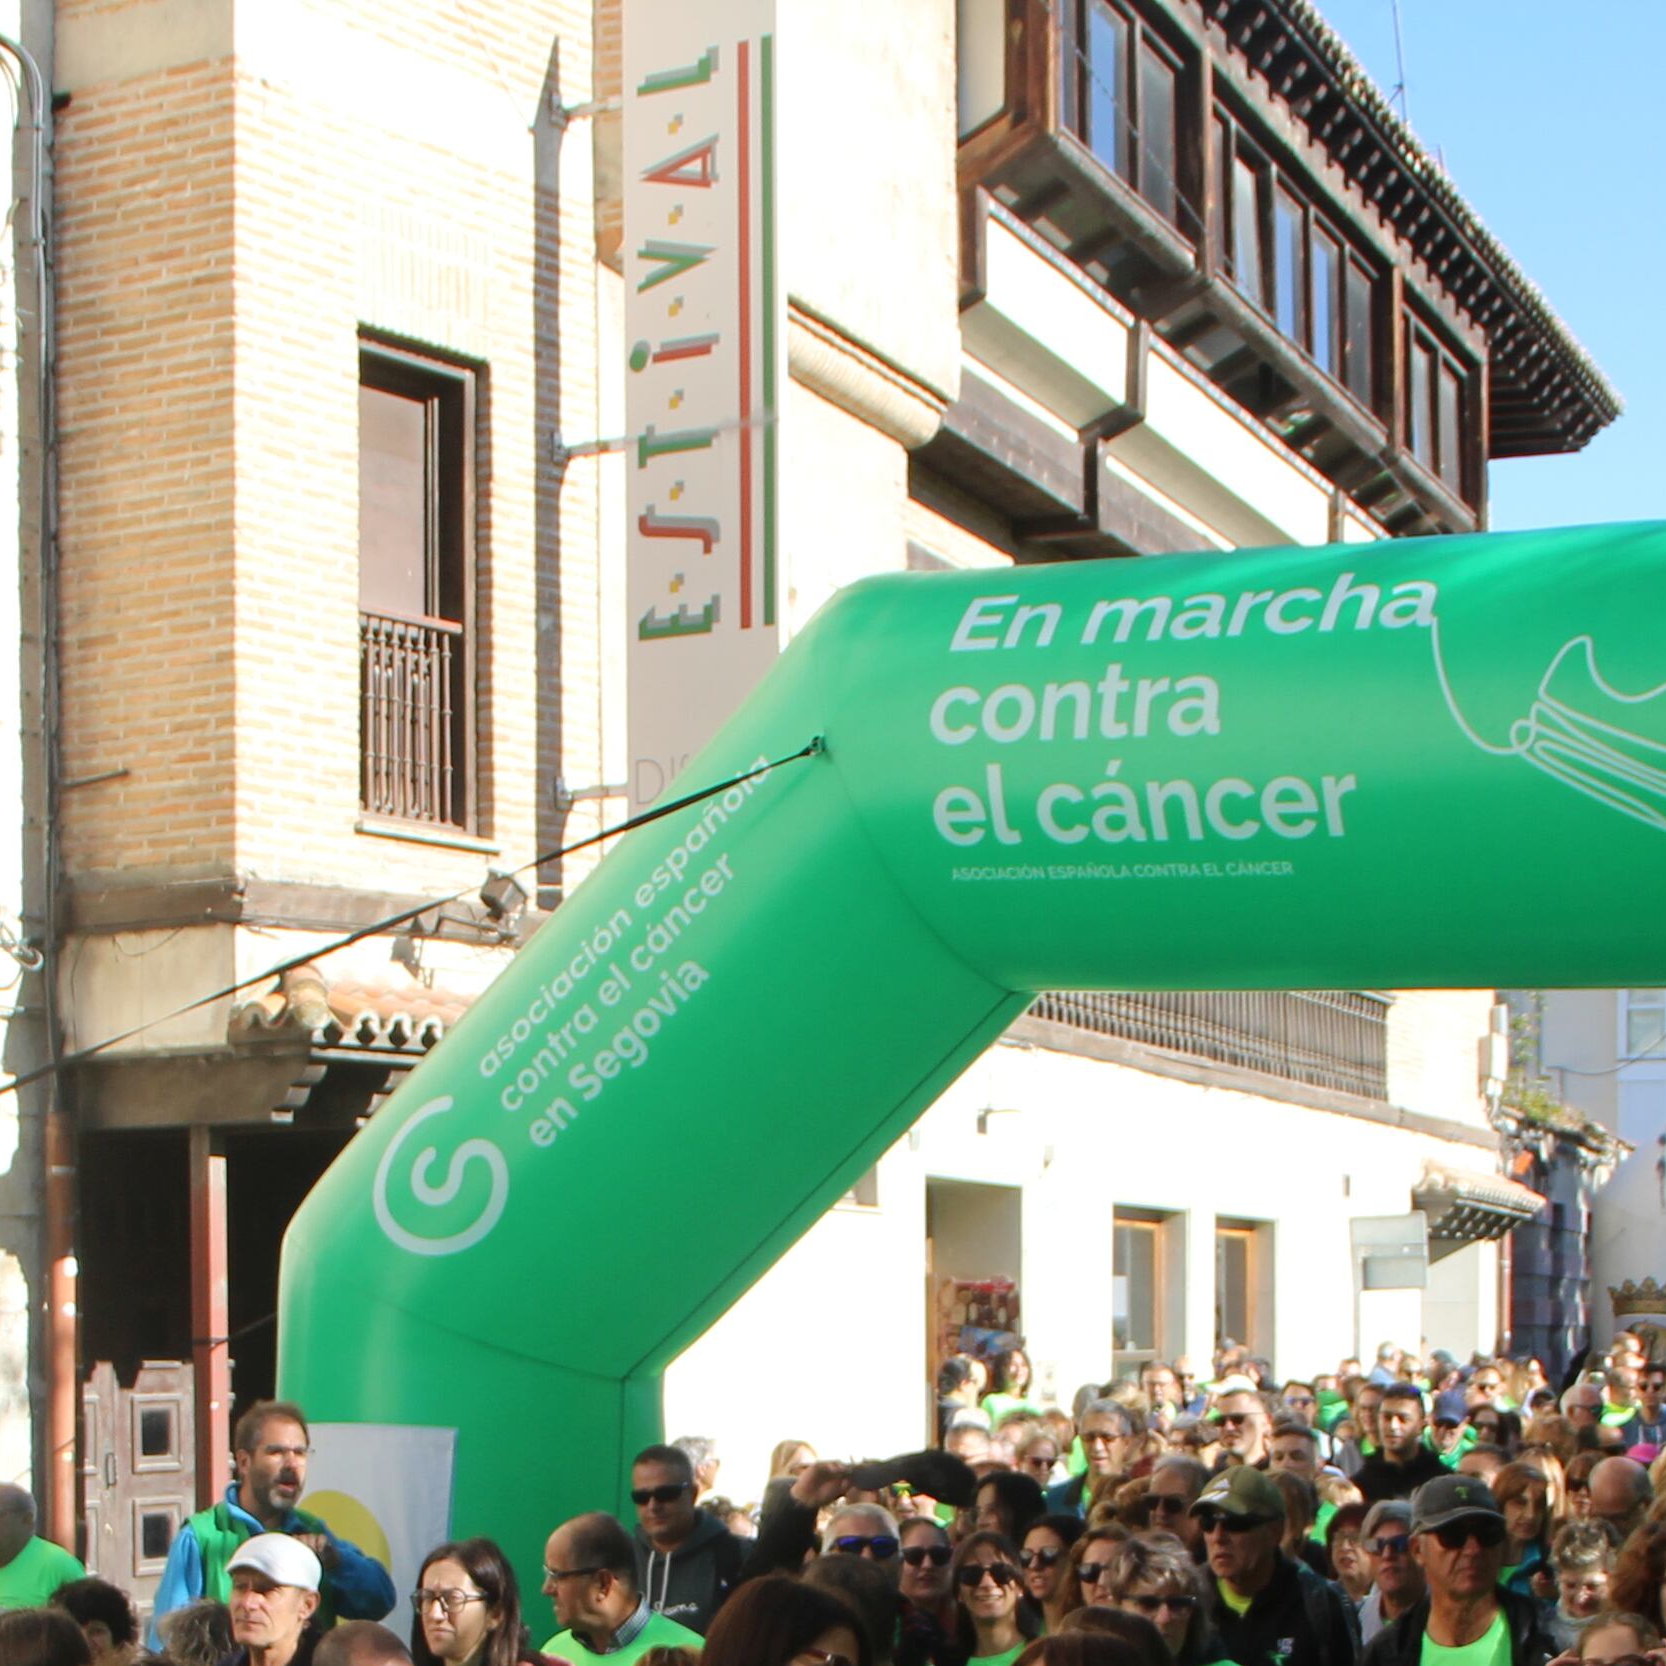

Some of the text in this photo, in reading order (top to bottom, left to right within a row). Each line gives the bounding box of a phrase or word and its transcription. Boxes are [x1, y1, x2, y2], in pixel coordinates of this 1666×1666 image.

[949, 572, 1437, 651] En marcha
[929, 663, 1221, 745] contra
[933, 759, 1357, 846] el cáncer
[952, 861, 1293, 881] ASOCIACIÓN ESPAÑOLA CONTRA EL CÁNCER
[479, 907, 633, 1078] asociación
[500, 851, 735, 1113] contra el cáncer
[528, 959, 711, 1148] en Segovia
